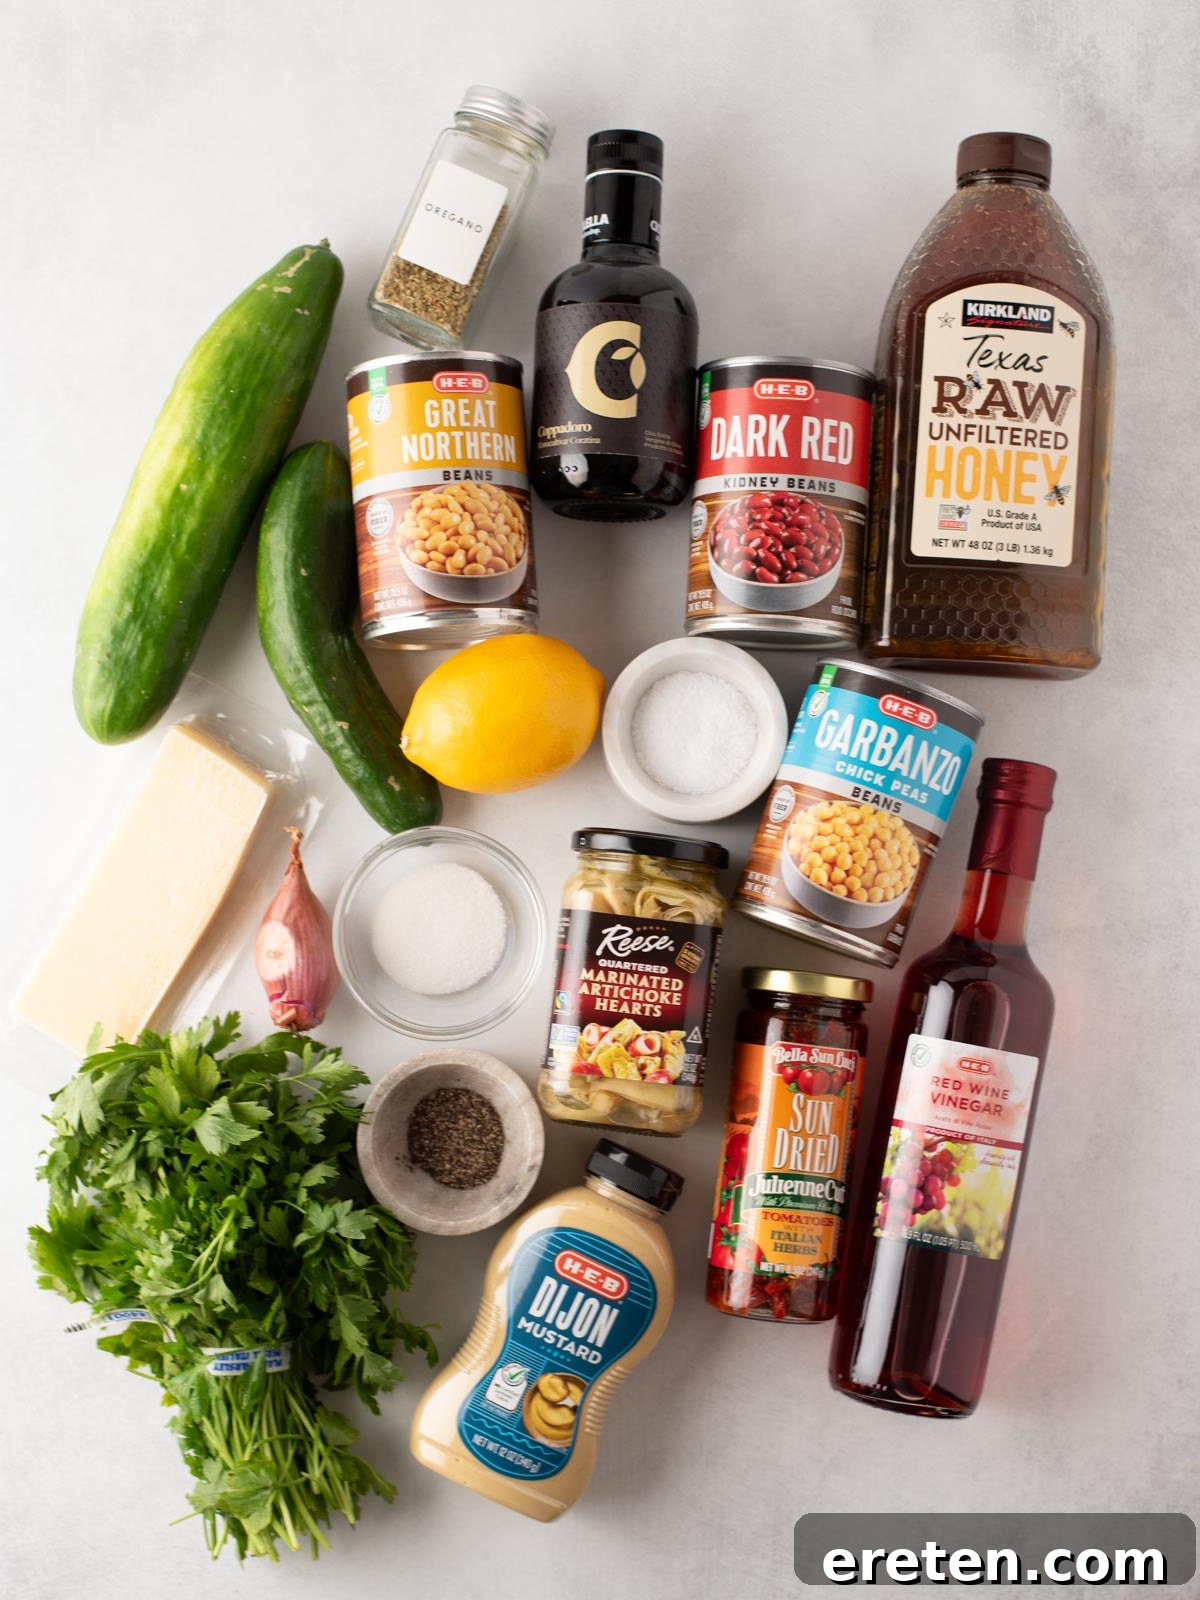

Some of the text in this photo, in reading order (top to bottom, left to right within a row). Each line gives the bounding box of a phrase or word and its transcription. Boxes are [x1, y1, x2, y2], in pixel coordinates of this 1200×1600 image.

[424, 203, 483, 233] OREGANO
[966, 302, 1052, 322] KIRKLAND
[966, 315, 1051, 329] Signature
[963, 334, 1049, 373] Texas
[424, 399, 497, 428] GREAT
[931, 375, 1078, 427] RAW
[401, 431, 517, 463] NORTHERN
[710, 414, 854, 466] DARK RED
[928, 422, 1069, 450] UNFILTERED
[443, 470, 493, 481] BEANS
[724, 476, 836, 493] KIDNEY BEANS
[925, 445, 1068, 507] HONEY
[981, 518, 1042, 532] Product of USA
[987, 508, 1037, 521] U.S. Grade A
[932, 538, 1054, 557] NET WT 48 OZ (3 LB) 1.36 kg
[814, 708, 962, 796] GARBANZO
[834, 761, 929, 804] CHICK PEAS
[851, 786, 902, 814] BEANS
[595, 923, 674, 957] Reese
[598, 958, 669, 975] QUARTERED
[579, 967, 684, 992] MARINATED
[578, 981, 683, 1006] ARTICHOKE
[594, 997, 663, 1018] HEARTS
[772, 1046, 808, 1065] Bella
[809, 1048, 835, 1065] Sun
[931, 1076, 1010, 1100] RED WINE
[789, 1093, 834, 1136] SUN
[931, 1091, 1004, 1117] VINEGAR
[925, 1126, 963, 1139] PRODUCT
[976, 1135, 998, 1146] ITALY
[772, 1127, 840, 1174] DRIED
[748, 1173, 824, 1199] Julienne
[762, 1210, 834, 1227] TOMATOES
[783, 1224, 815, 1233] WITH
[769, 1230, 824, 1244] ITALIAN
[773, 1242, 818, 1256] HERBS
[528, 1275, 620, 1349] DIJON
[517, 1317, 603, 1366] MUSTARD
[472, 1433, 488, 1448] NET
